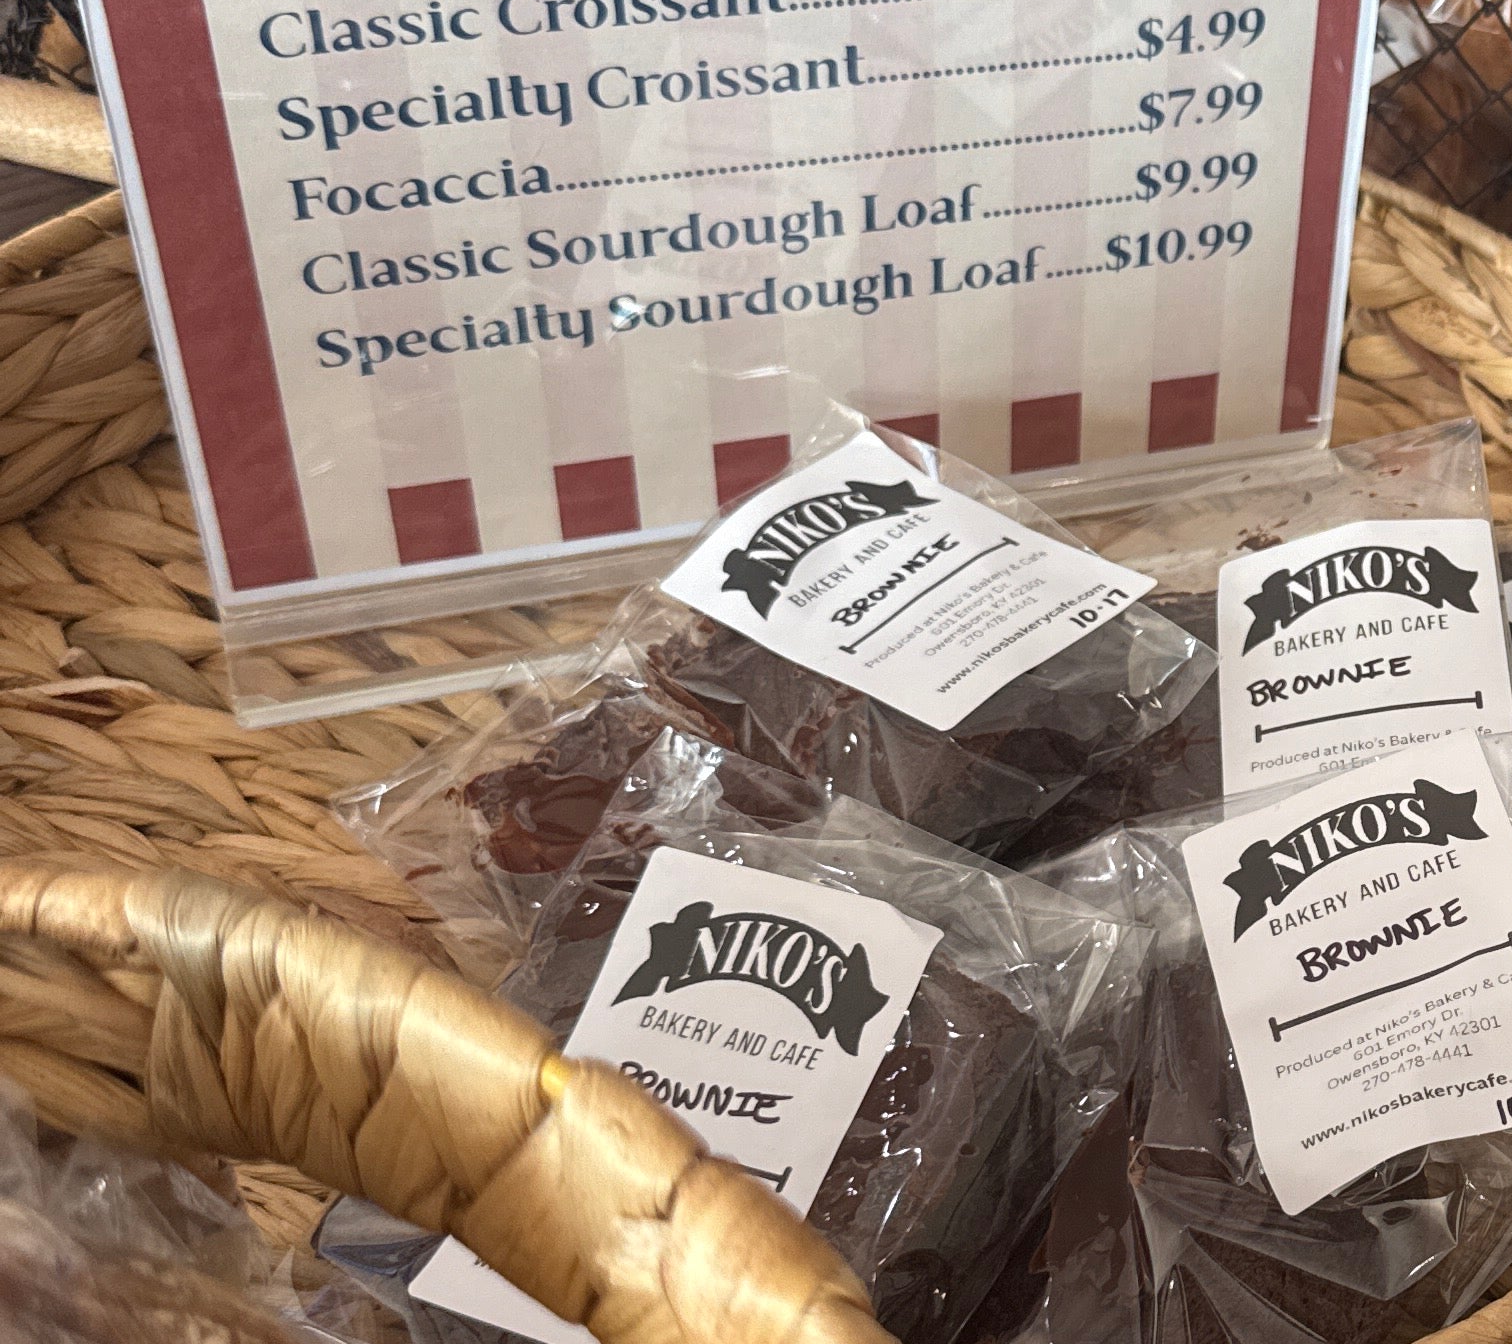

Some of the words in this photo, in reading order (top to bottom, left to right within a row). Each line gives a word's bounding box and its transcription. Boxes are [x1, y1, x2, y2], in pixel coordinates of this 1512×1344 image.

[259, 1, 482, 58] Classic
[277, 75, 574, 149] Specialty
[588, 46, 865, 109] Croissant
[1135, 8, 1267, 60] $4.99
[288, 159, 553, 221] Focaccia
[1137, 82, 1264, 133] $7.99
[302, 241, 511, 296] Classic
[527, 201, 845, 270] Sourdough
[862, 184, 982, 234] Loaf
[1134, 152, 1259, 203] $9.99
[316, 302, 594, 377] Specialty
[610, 264, 913, 332] Sourdough
[930, 246, 1046, 295] Loaf
[1104, 220, 1254, 273] $10.99
[748, 492, 888, 576] NIKO'S
[788, 561, 855, 607] BAKERY
[854, 538, 889, 564] AND
[886, 513, 932, 540] CAFE
[831, 533, 960, 627] BROWNIE
[864, 624, 925, 669] Produced
[922, 615, 937, 628] at
[933, 591, 972, 620] Niko's
[971, 566, 1011, 593] Bakery
[1009, 561, 1022, 572] &
[931, 614, 956, 636] 601
[955, 590, 994, 622] Emory
[1007, 578, 1046, 600] 42301
[1285, 550, 1431, 618] NIKO'S
[937, 583, 1107, 694] www.nikosbakerycafe.com
[1273, 626, 1348, 657] BAKERY
[1355, 619, 1393, 640] AND
[1401, 613, 1450, 634] CAFE
[1246, 656, 1412, 708] BROWNIE
[1251, 747, 1320, 772] Produced
[1323, 745, 1338, 756] at
[1342, 737, 1386, 754] Niko's
[1267, 798, 1432, 891] NIKO'S
[1268, 890, 1349, 938] BAKERY
[1359, 872, 1402, 903] AND
[1407, 848, 1462, 883] CAFE
[680, 920, 848, 1015] NIKO'S
[1296, 898, 1468, 983] BROWNIE
[640, 1006, 723, 1044] BAKERY
[723, 1027, 767, 1056] AND
[770, 1039, 824, 1070] CAFE
[1275, 1038, 1353, 1078] Produced
[1356, 1031, 1372, 1045] at
[1374, 1009, 1420, 1037] Niko's
[1424, 982, 1478, 1011] Bakery
[1482, 978, 1495, 989] &
[1327, 1041, 1421, 1091] Owensboro,
[1424, 1031, 1445, 1045] KY
[1449, 1015, 1502, 1037] 42301
[1353, 1041, 1383, 1061] 601
[1387, 1018, 1437, 1046] Emory
[1441, 1006, 1463, 1022] Dr.
[1362, 1043, 1473, 1093] 270-478-4441
